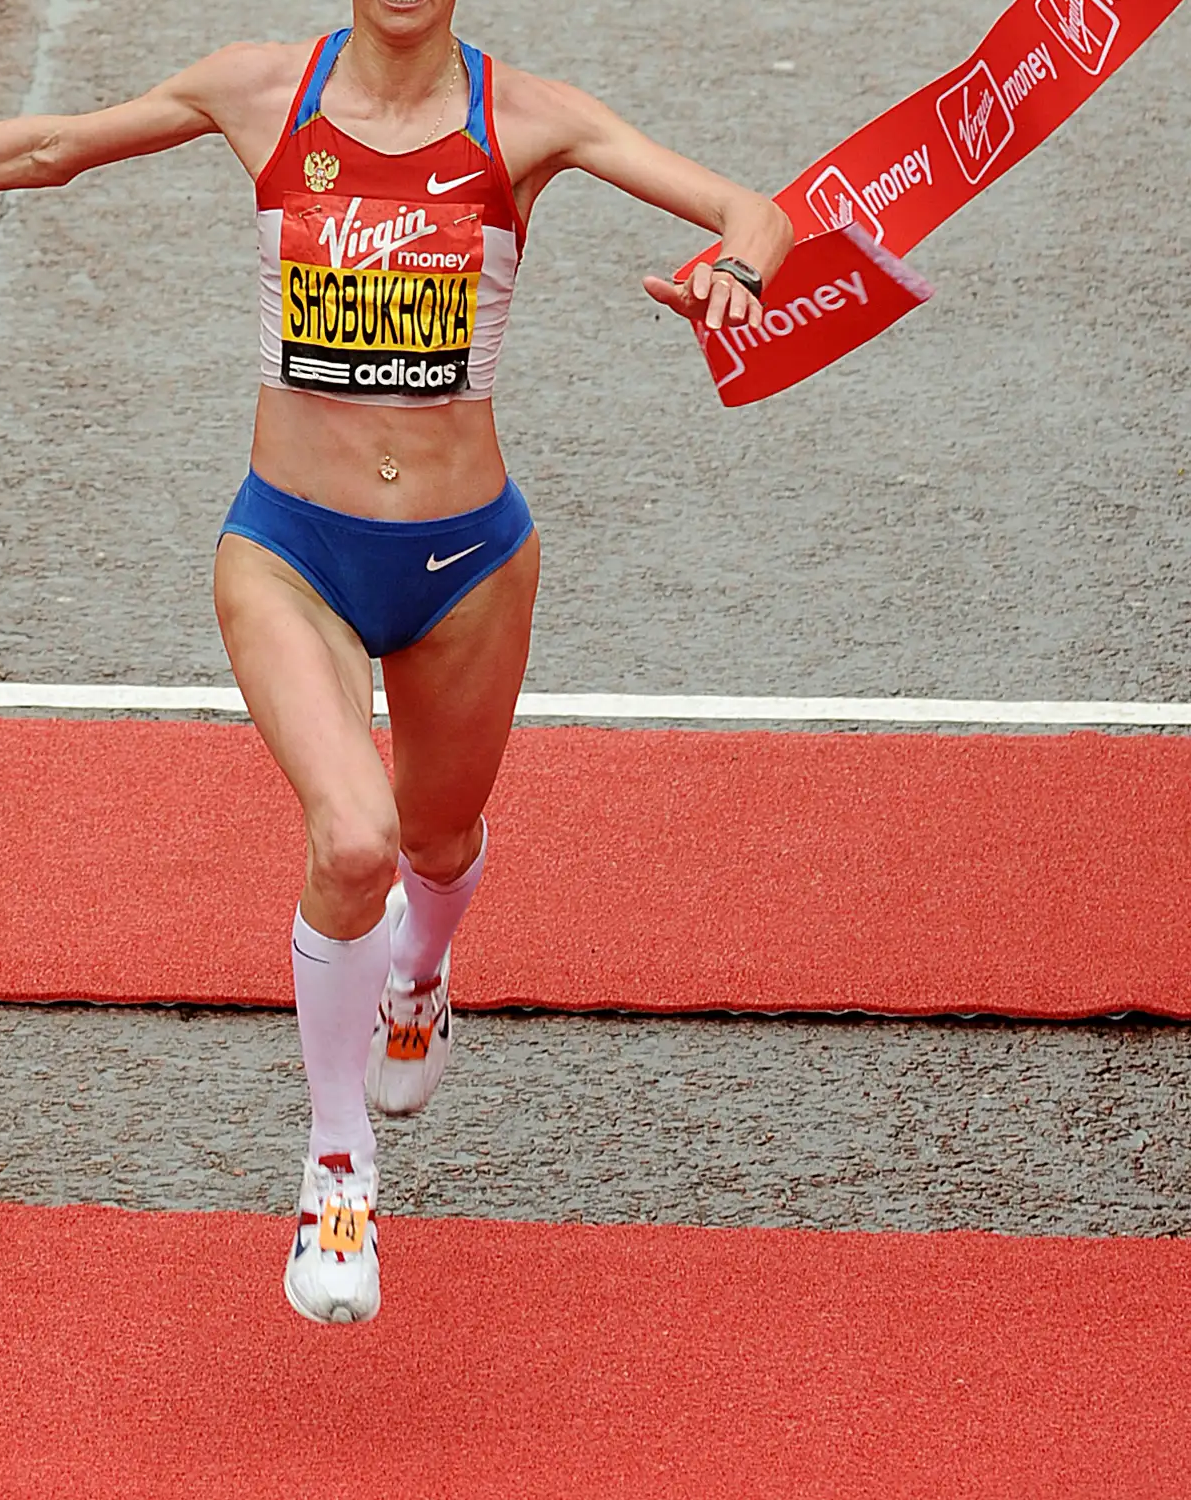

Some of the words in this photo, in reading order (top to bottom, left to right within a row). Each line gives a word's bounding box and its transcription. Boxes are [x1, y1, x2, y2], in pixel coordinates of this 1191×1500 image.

[958, 85, 994, 160] Virgin
[1003, 42, 1057, 110] money
[862, 144, 933, 214] money
[318, 196, 437, 271] Virgin
[397, 250, 470, 271] money
[289, 266, 469, 348] SHOBUKHOVA
[354, 358, 457, 388] adidas
